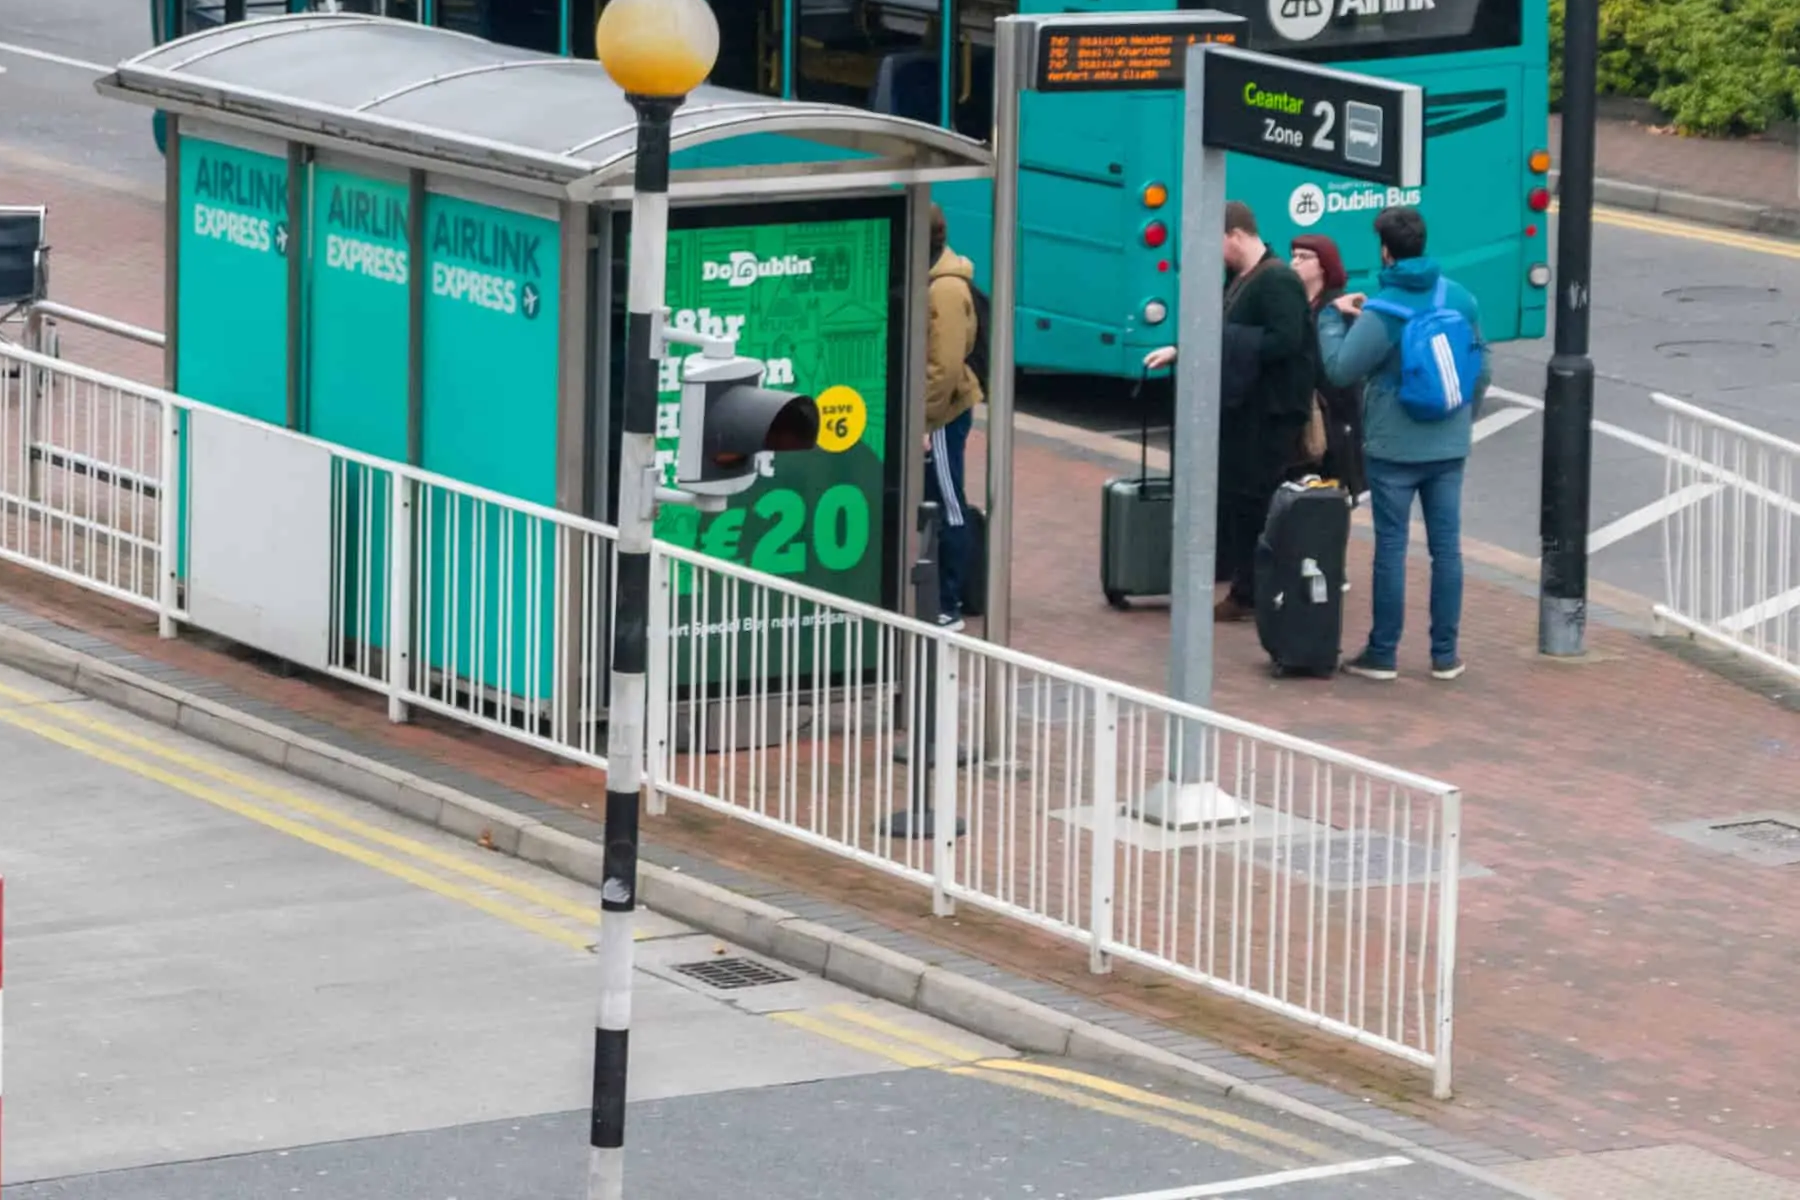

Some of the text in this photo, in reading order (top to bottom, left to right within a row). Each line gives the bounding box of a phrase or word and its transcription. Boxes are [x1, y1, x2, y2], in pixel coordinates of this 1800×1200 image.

[1244, 81, 1304, 115] Ceantar
[1263, 100, 1336, 151] Zone 2
[194, 157, 289, 214] AIRLINK
[1327, 185, 1421, 213] Dublin Bus
[195, 204, 270, 253] EXPRESS
[326, 184, 410, 246] AIRLIN
[326, 234, 408, 285] EXPRESS
[432, 211, 541, 277] AIRLINK
[702, 251, 814, 286] DoDublin
[432, 262, 516, 314] EXPRESS
[822, 404, 853, 414] save
[699, 484, 870, 574] €20
